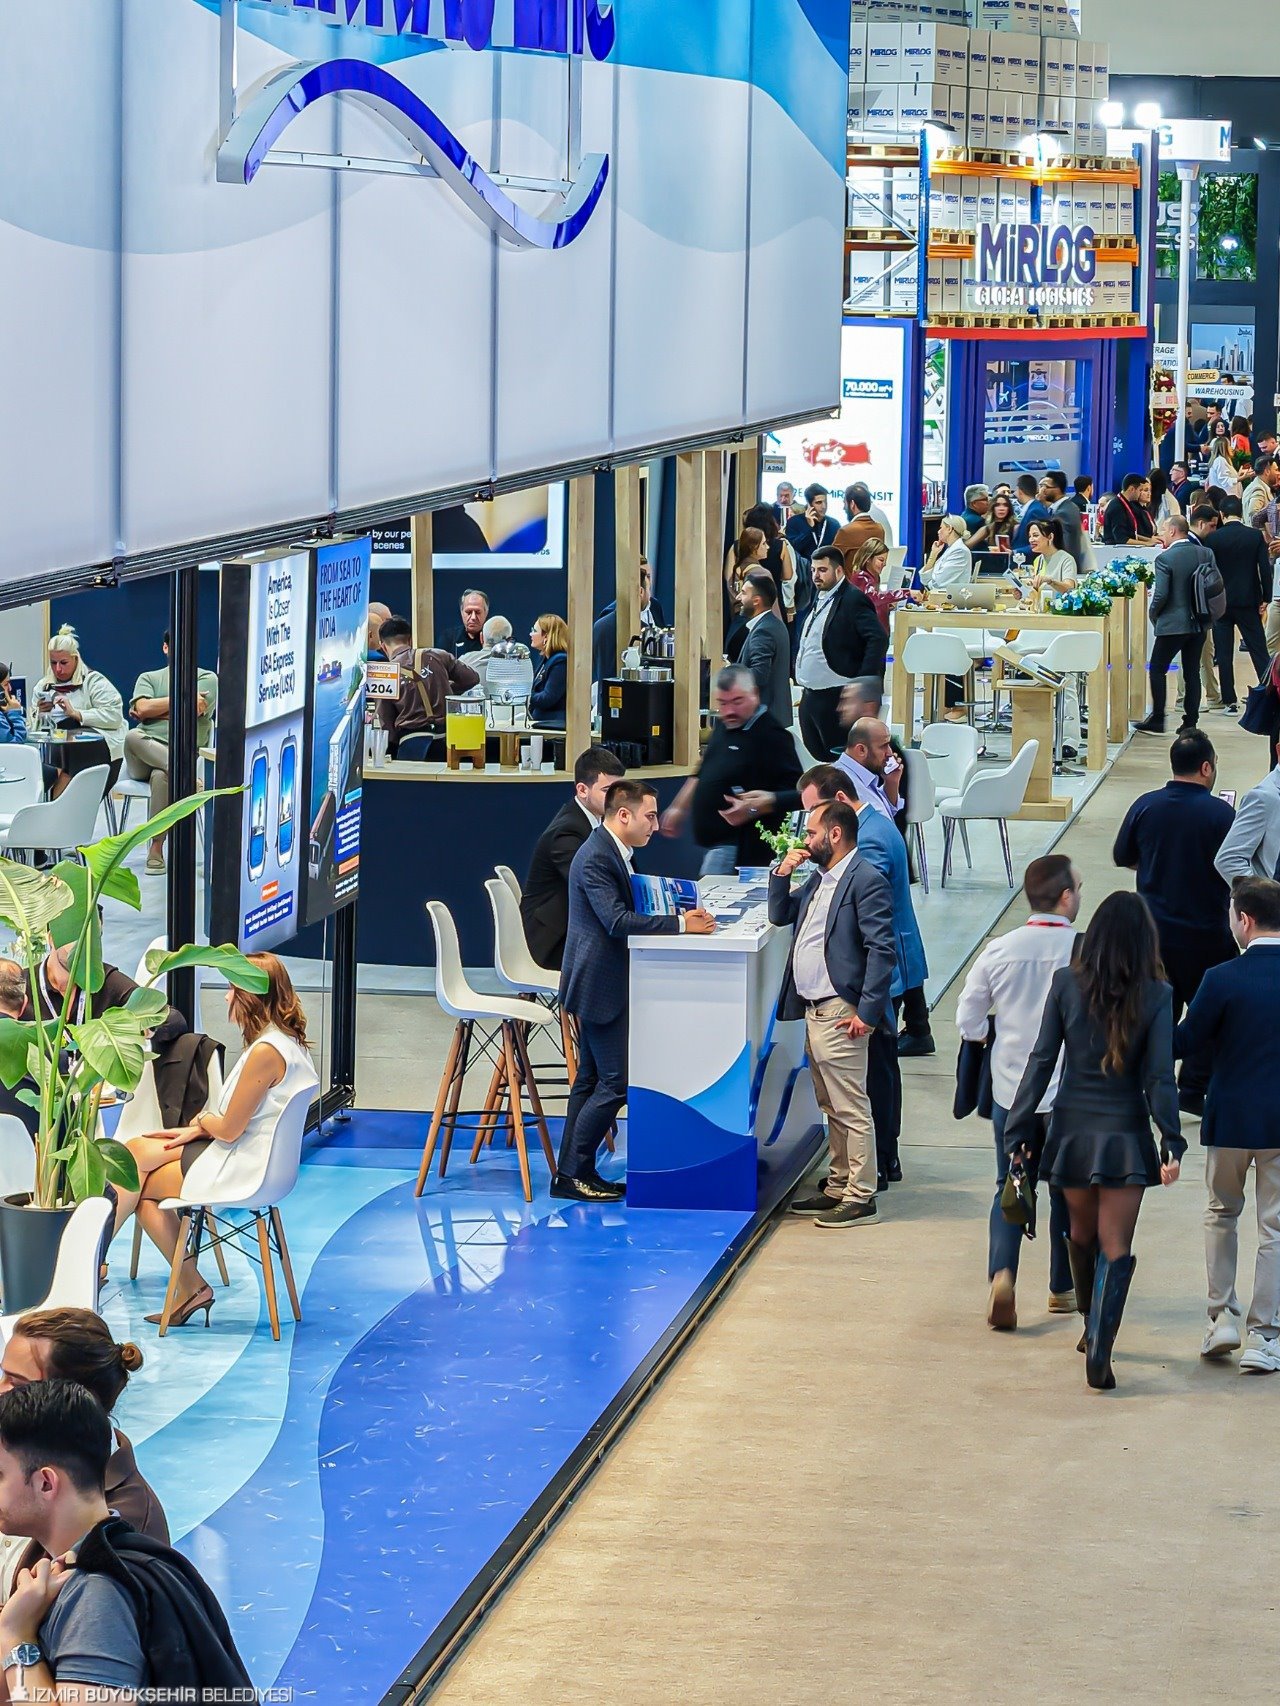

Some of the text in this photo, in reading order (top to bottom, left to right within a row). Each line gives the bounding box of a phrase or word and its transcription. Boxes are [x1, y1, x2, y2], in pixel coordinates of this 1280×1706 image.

[870, 48, 897, 56] MIRLOG
[904, 48, 932, 56] MIRLOG
[867, 108, 894, 117] MIRLOG
[901, 109, 928, 117] MIRLOG
[894, 277, 918, 285] MIRLO
[975, 287, 1095, 306] GLOBAL LOGISTICS
[1154, 346, 1175, 354] RAGE
[845, 381, 878, 392] 70.000
[1195, 387, 1245, 396] WAREHOUSING
[372, 530, 383, 540] by
[373, 542, 405, 550] scenes
[320, 555, 361, 584] FROM SEA TO
[319, 582, 362, 613] THE HEART OF
[268, 599, 291, 620] Is Closer
[318, 617, 337, 640] INDIA
[266, 622, 291, 647] With The
[260, 650, 295, 677] USA Express
[258, 679, 280, 703] Service
[365, 683, 393, 694] A204
